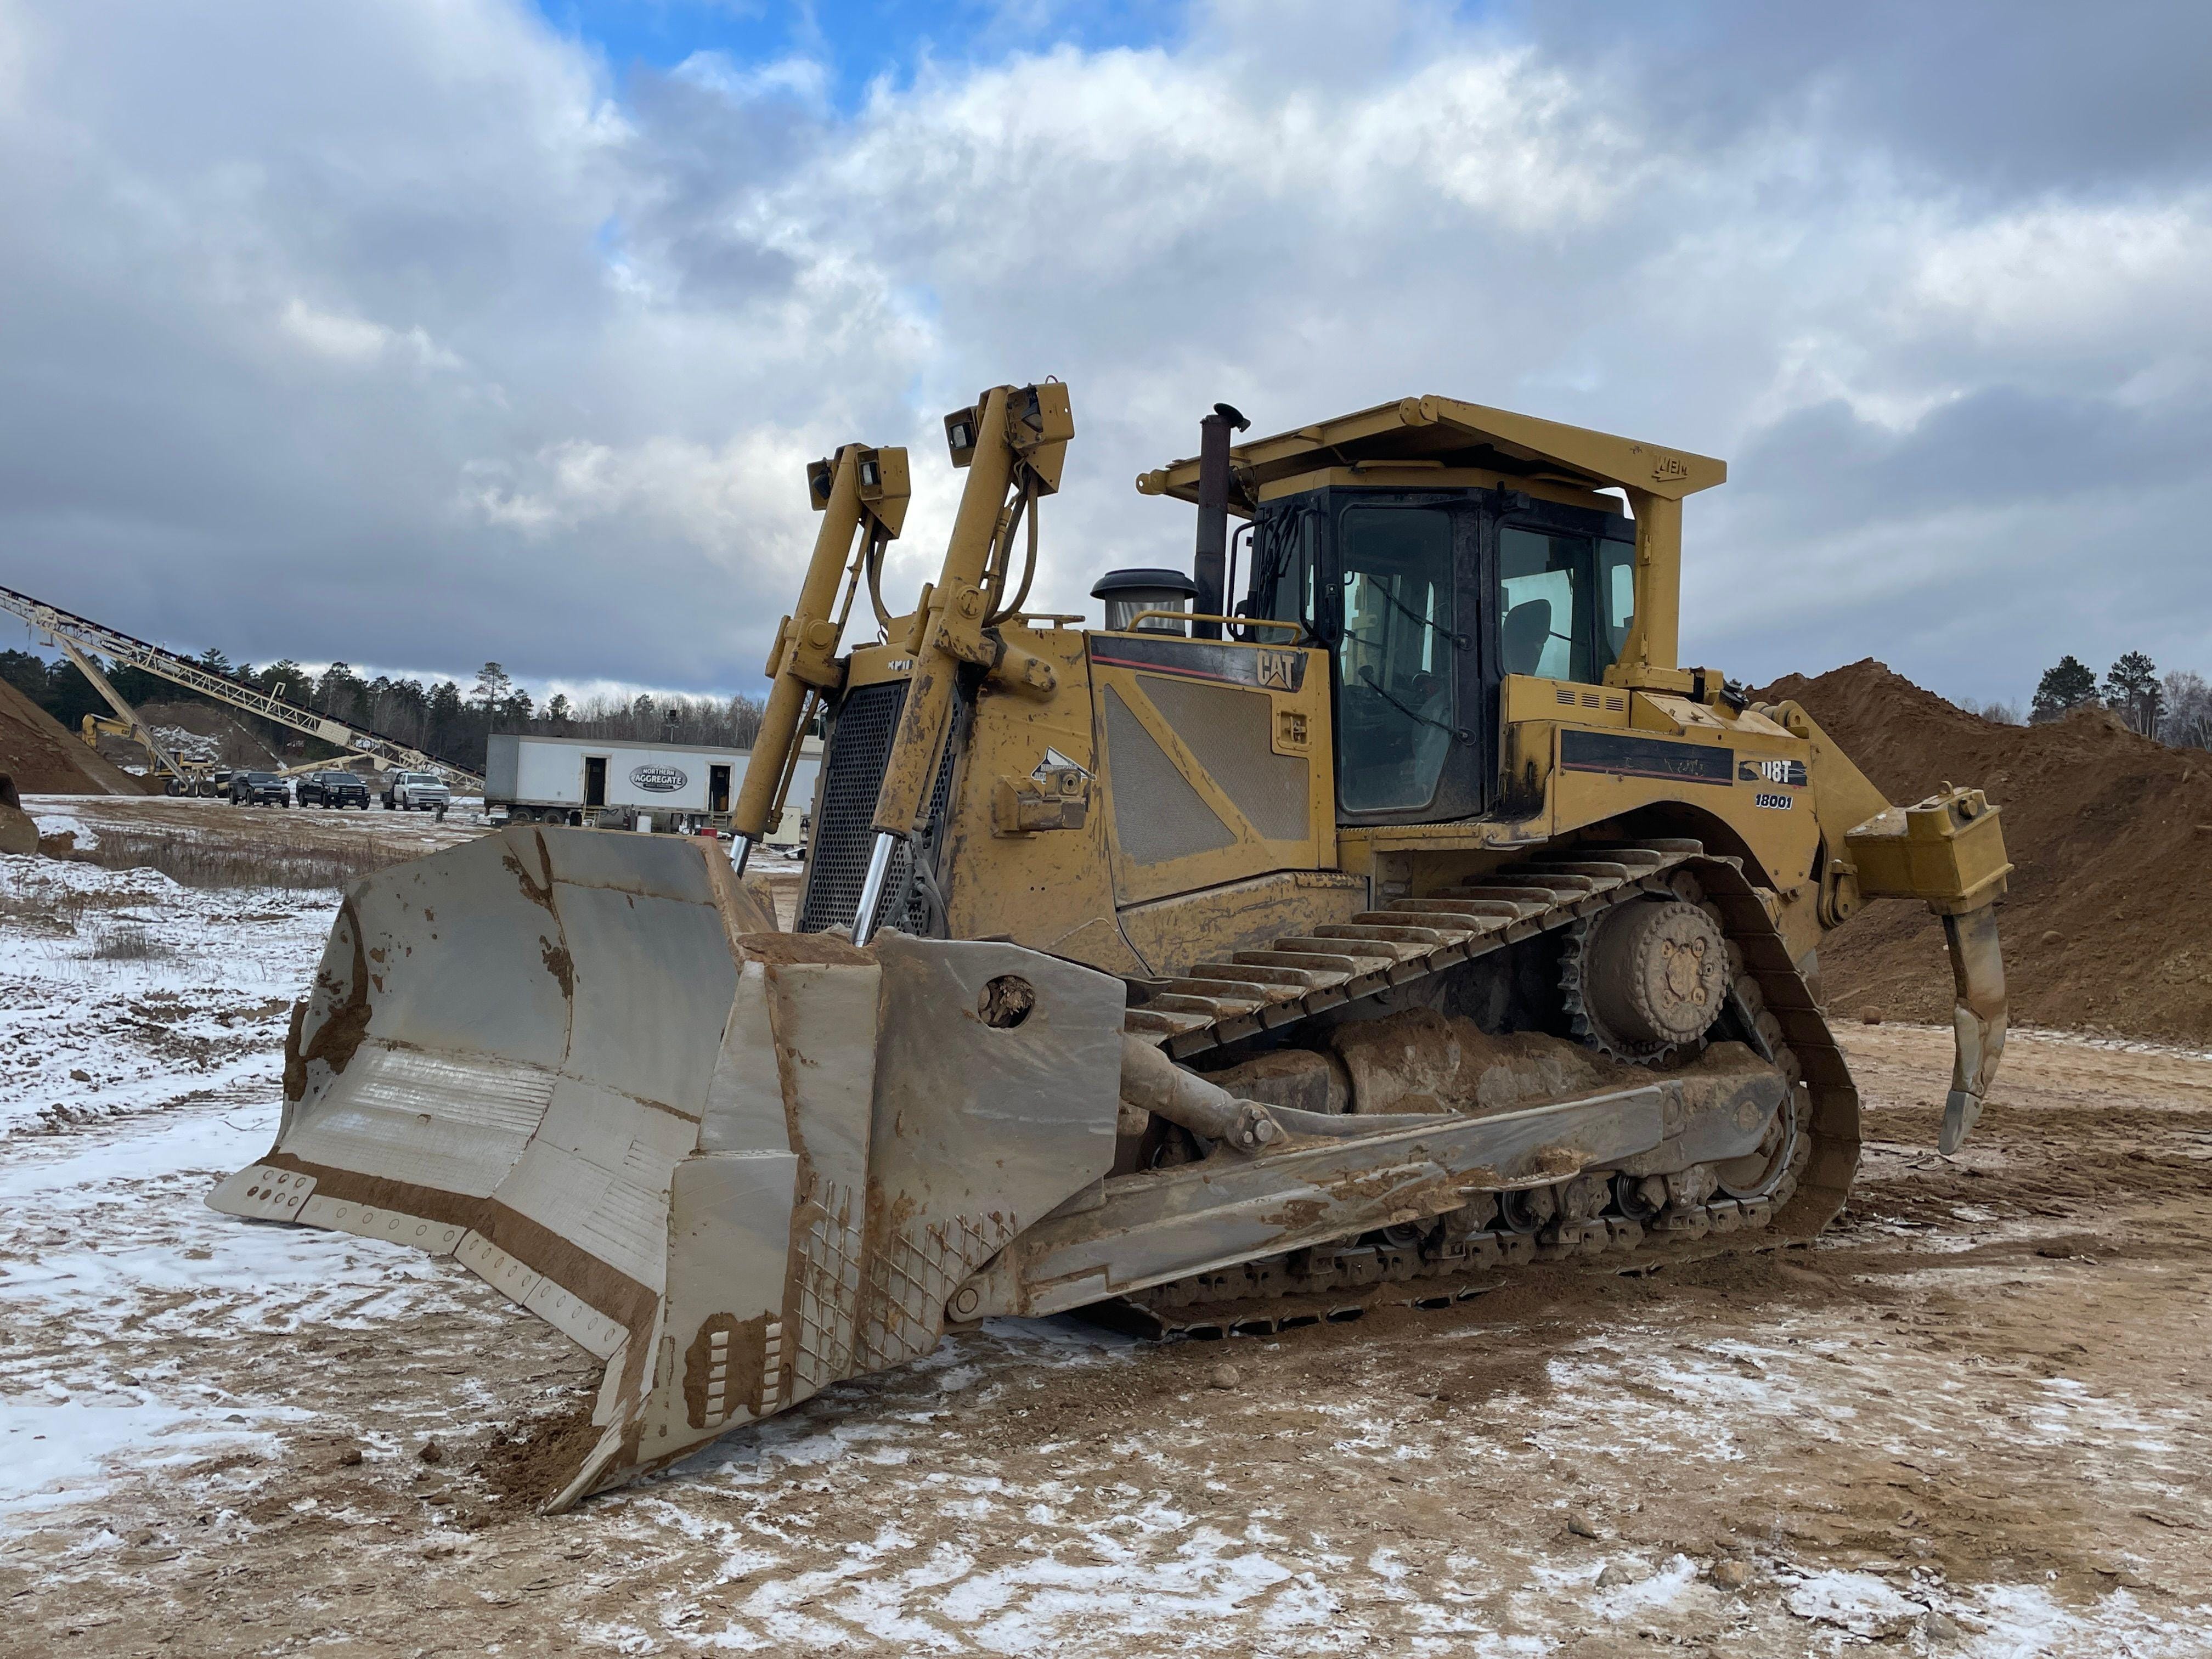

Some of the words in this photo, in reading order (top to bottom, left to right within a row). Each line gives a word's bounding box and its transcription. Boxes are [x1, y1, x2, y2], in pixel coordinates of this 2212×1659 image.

[1257, 650, 1294, 690] CAT
[642, 768, 675, 776] NORTHERN
[635, 774, 682, 785] AGGREGATE
[1756, 794, 1793, 810] 18001
